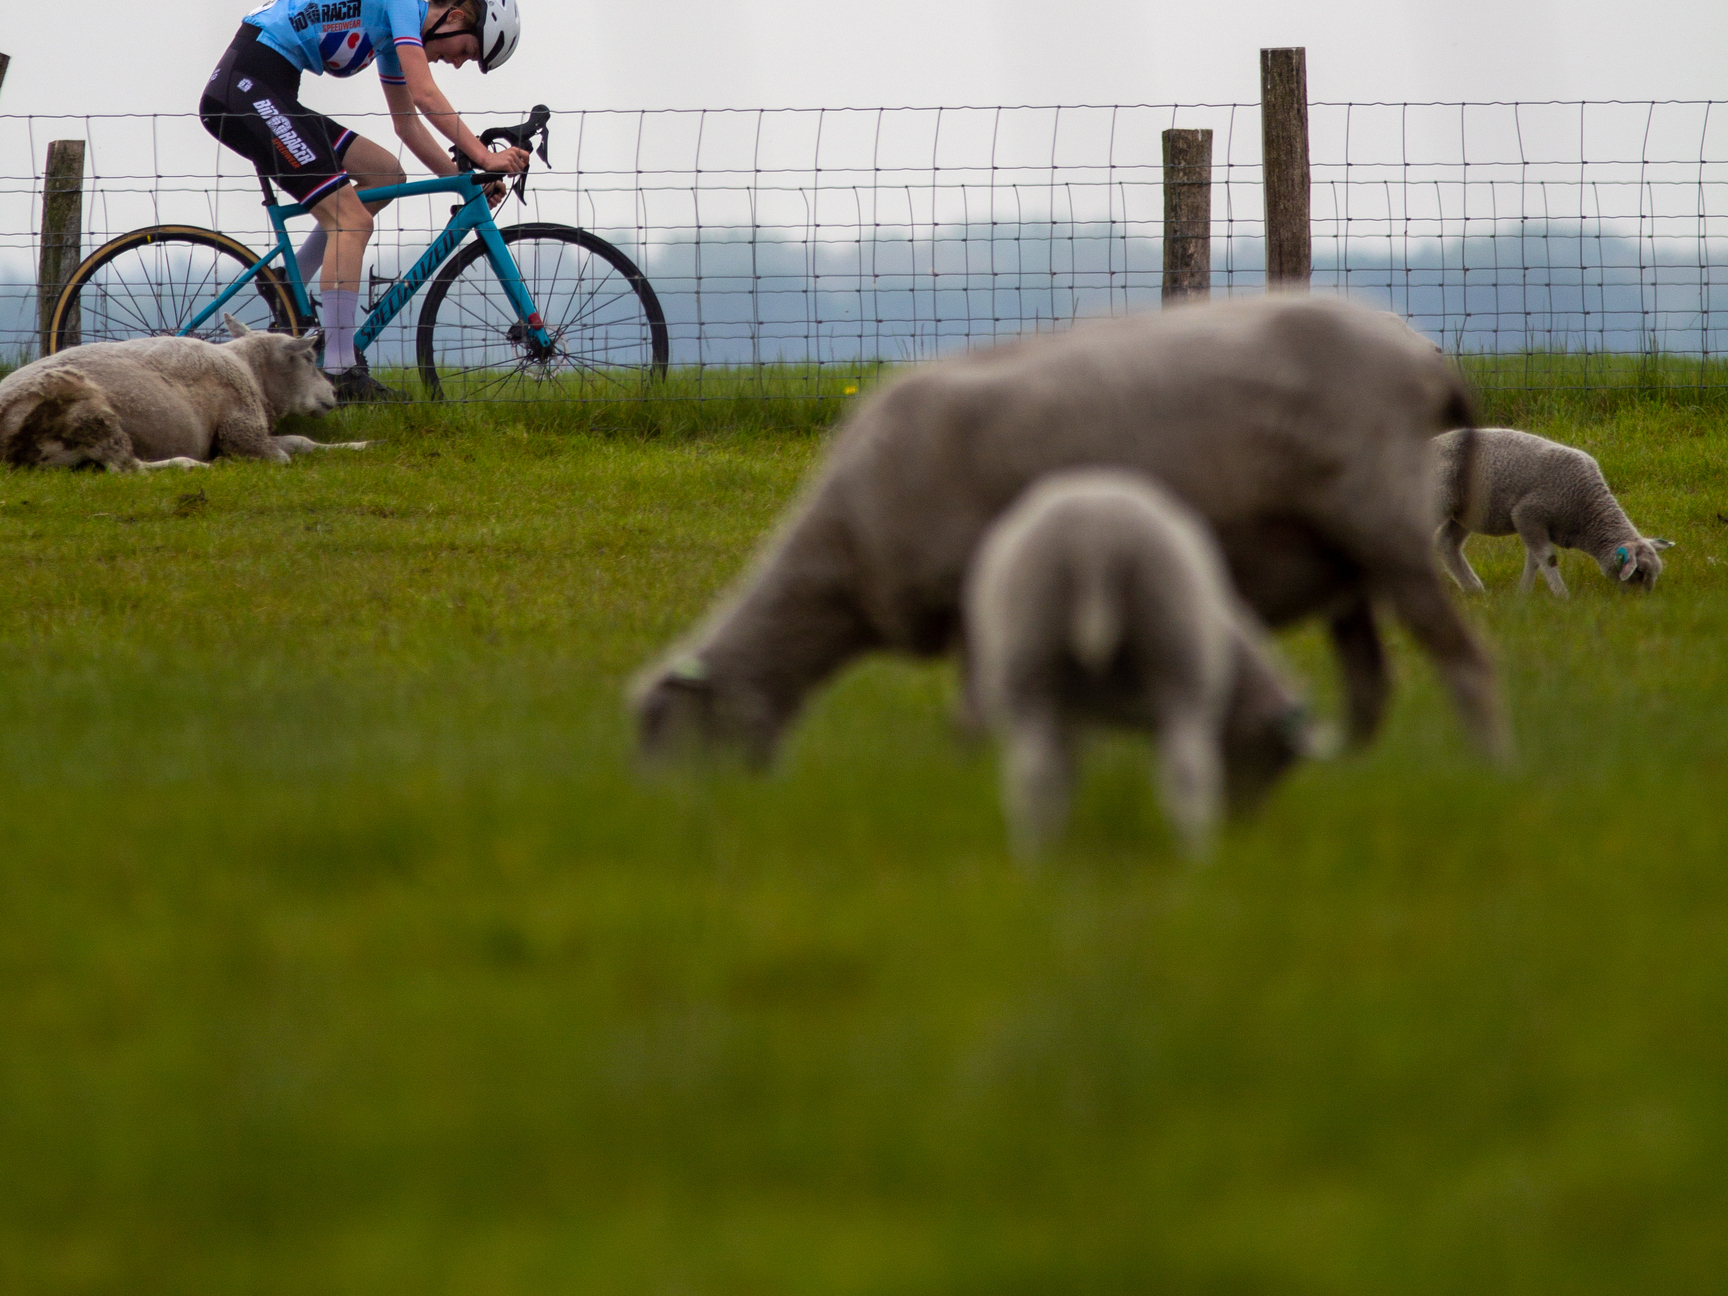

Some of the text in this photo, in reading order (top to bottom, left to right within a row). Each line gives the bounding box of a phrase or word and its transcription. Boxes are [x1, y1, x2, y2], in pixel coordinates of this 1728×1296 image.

[322, 0, 361, 21] RACER
[322, 19, 361, 33] SPEEDWEAR
[272, 137, 300, 169] SPEEDWEAR
[279, 131, 316, 165] RACER
[360, 230, 455, 344] SPECIALIZED
